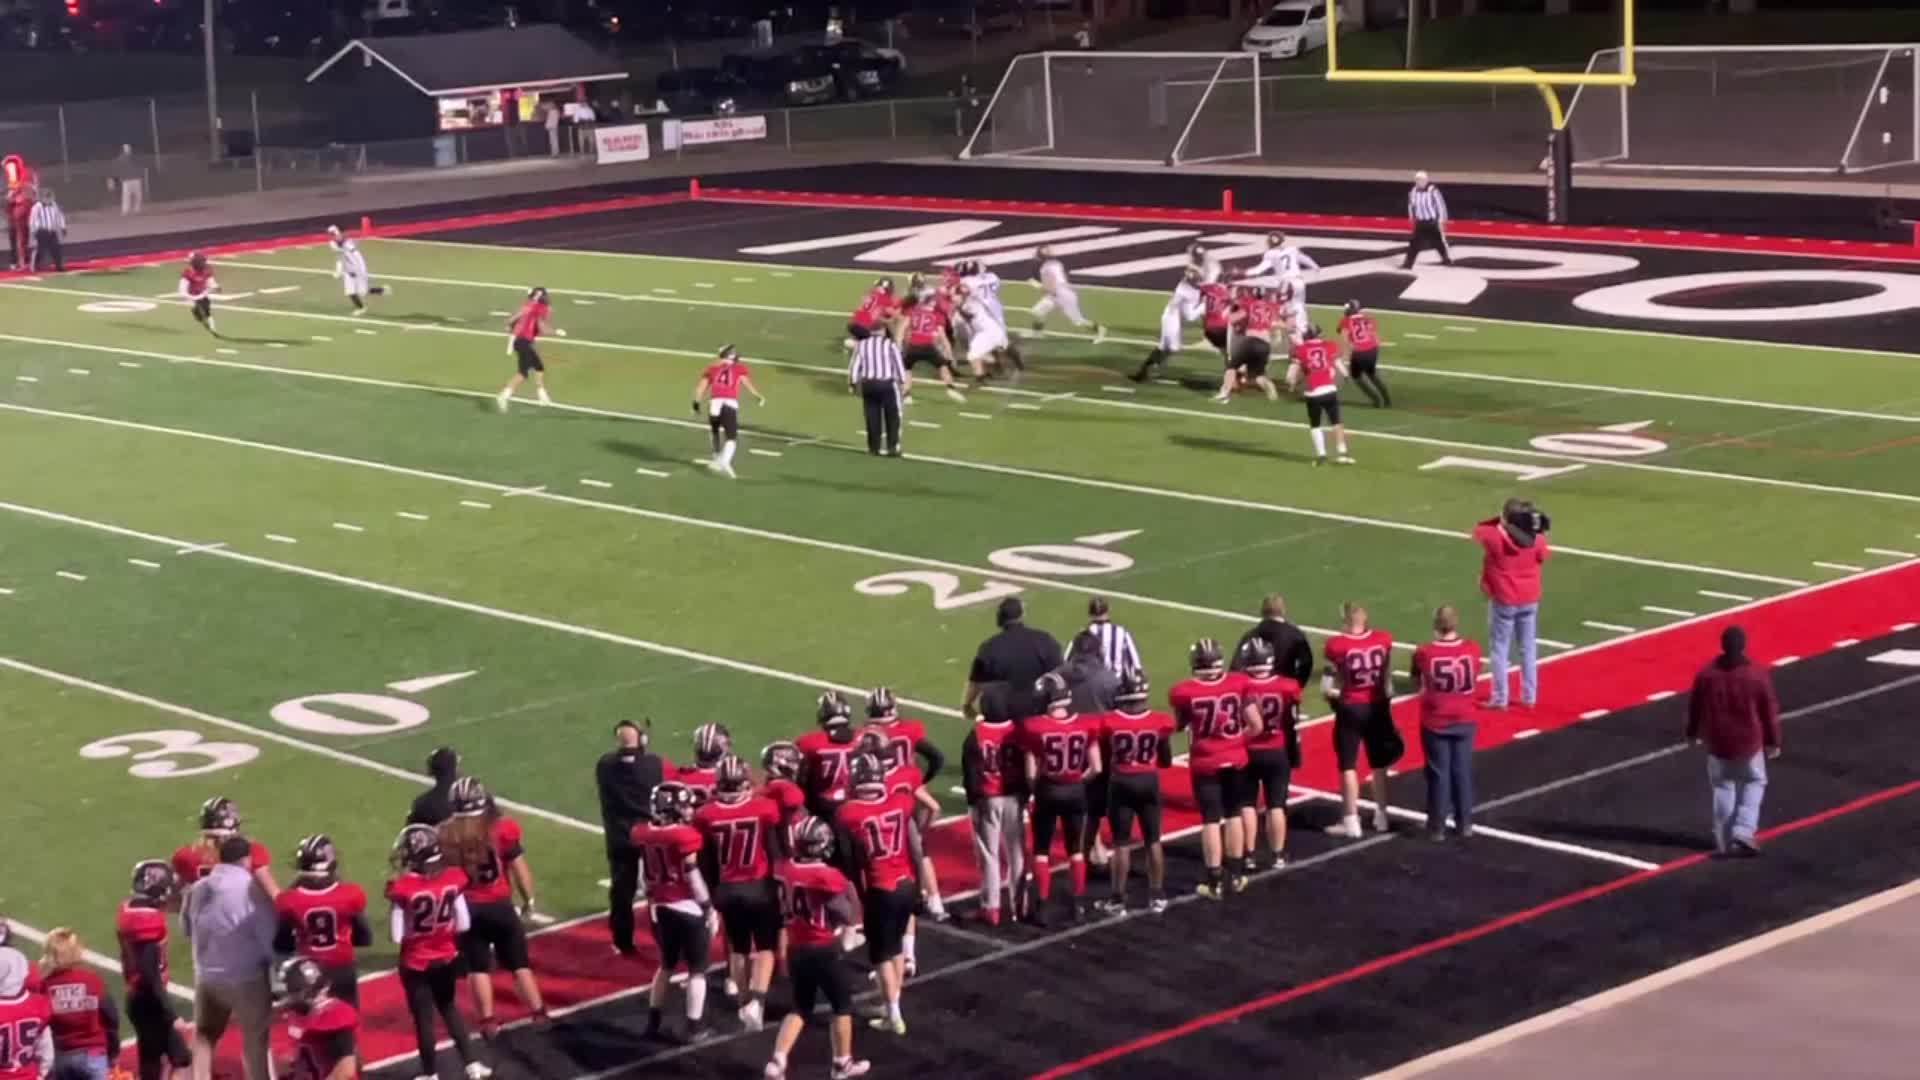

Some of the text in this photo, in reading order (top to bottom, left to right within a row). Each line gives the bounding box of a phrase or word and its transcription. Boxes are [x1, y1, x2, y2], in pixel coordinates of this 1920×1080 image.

[716, 367, 732, 388] 4
[1307, 348, 1328, 370] 3
[1419, 433, 1668, 482] 10
[853, 544, 1134, 610] 20
[1430, 655, 1475, 695] 51
[79, 693, 430, 779] 30
[1191, 692, 1243, 740] 73
[1110, 729, 1159, 769] 28
[711, 816, 760, 869] 77
[861, 808, 905, 860] 17
[303, 906, 338, 951] 9
[410, 883, 460, 936] 24
